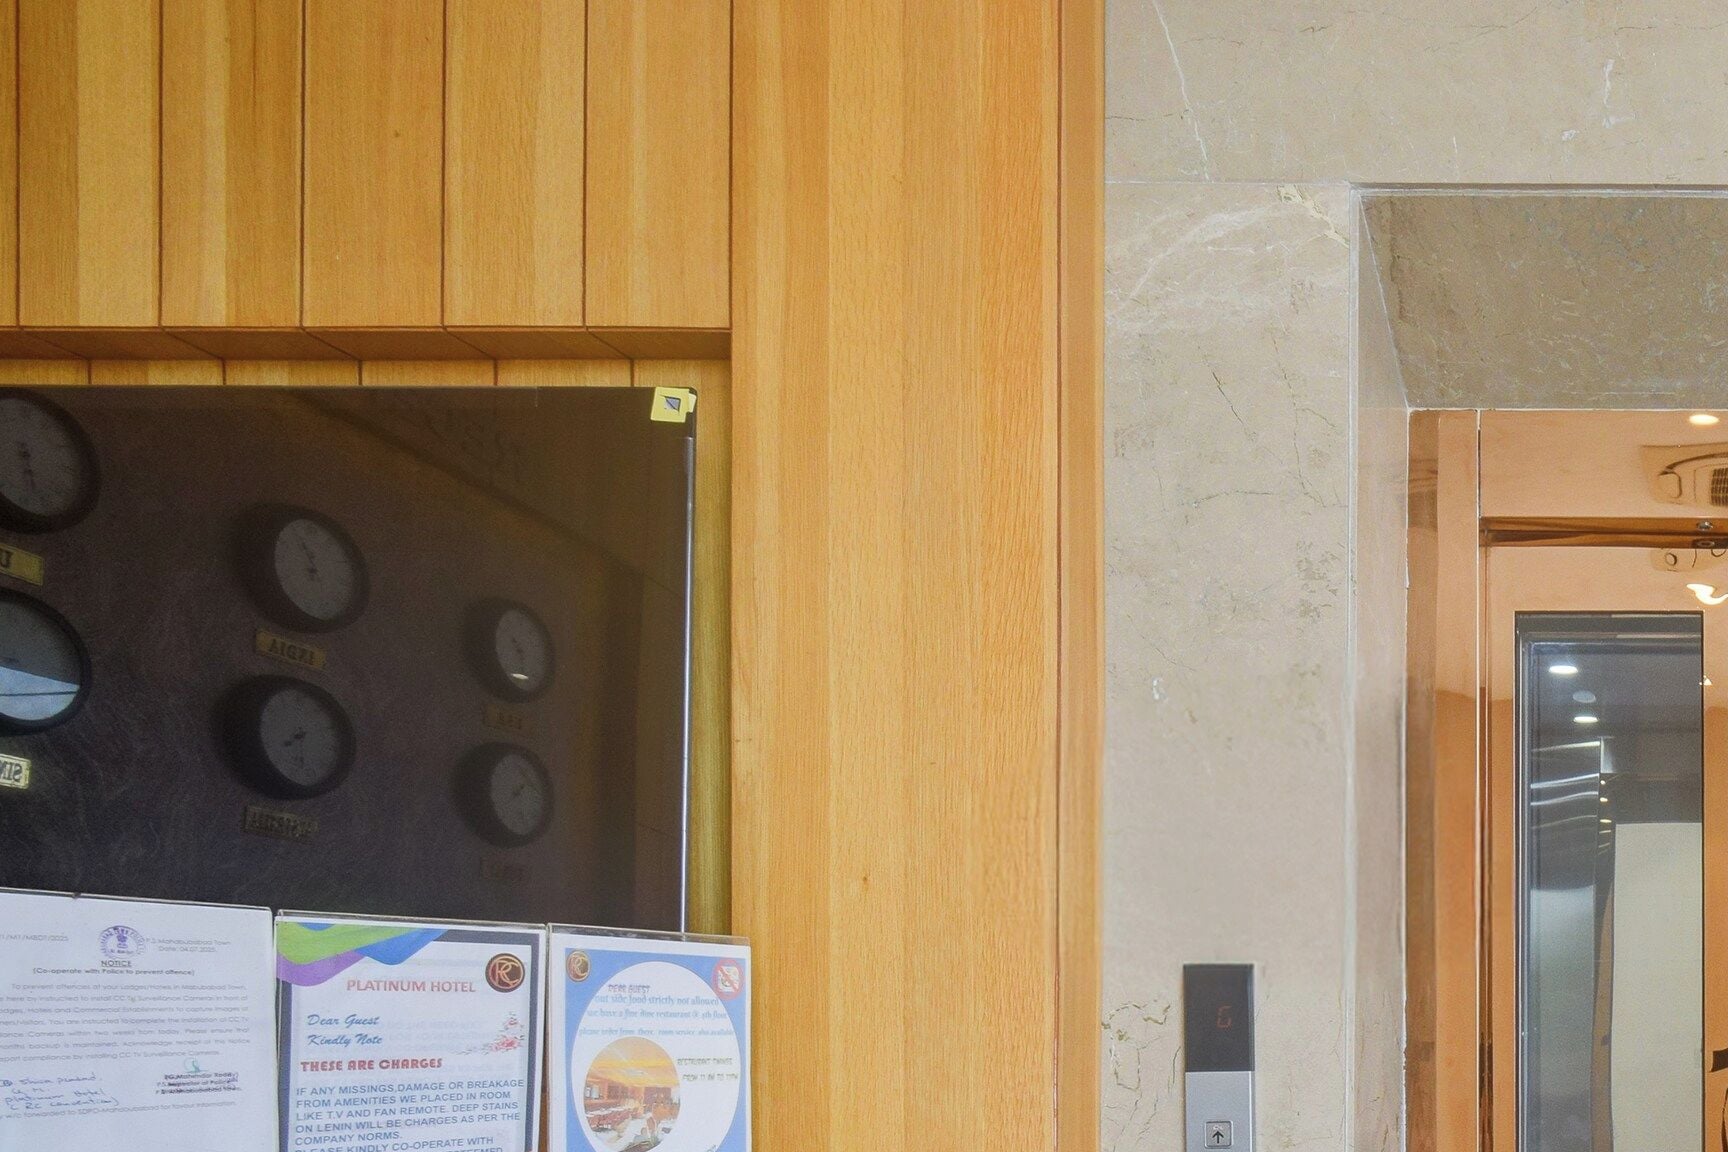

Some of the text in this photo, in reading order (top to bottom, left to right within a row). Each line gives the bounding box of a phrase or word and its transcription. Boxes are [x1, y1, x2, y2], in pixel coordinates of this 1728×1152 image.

[347, 979, 426, 991] PLATINUM
[431, 981, 476, 992] HOTEL
[648, 995, 674, 1006] strictly
[677, 996, 689, 1005] not
[307, 1013, 380, 1028] Dear Guest
[657, 1010, 691, 1018] restaurant
[307, 1033, 383, 1048] Kindly Note
[301, 1058, 442, 1072] THESE ARE CHARGES
[310, 1087, 335, 1095] ANY
[449, 1081, 463, 1090] OR
[467, 1079, 524, 1088] BREAKAGE
[296, 1099, 331, 1108] FROM
[334, 1096, 396, 1107] AMENITIES
[400, 1095, 416, 1103] WE
[421, 1093, 463, 1103] PLACED
[480, 1091, 510, 1099] ROOM
[296, 1112, 323, 1121] LIKE
[327, 1111, 344, 1119] T.V
[346, 1110, 370, 1118] AND
[374, 1108, 396, 1116] FAN
[452, 1104, 479, 1112] DEEP
[482, 1102, 518, 1111] STAINS
[296, 1125, 313, 1133] ON
[317, 1122, 352, 1132] LENIN
[356, 1121, 383, 1130] WILL
[386, 1119, 401, 1128] BE
[405, 1117, 458, 1127] CHARGES
[478, 1114, 498, 1122] PER
[295, 1131, 402, 1146] COMPANY NORMS.
[392, 1138, 464, 1151] CO-OPERATE
[467, 1136, 493, 1145] WITH
